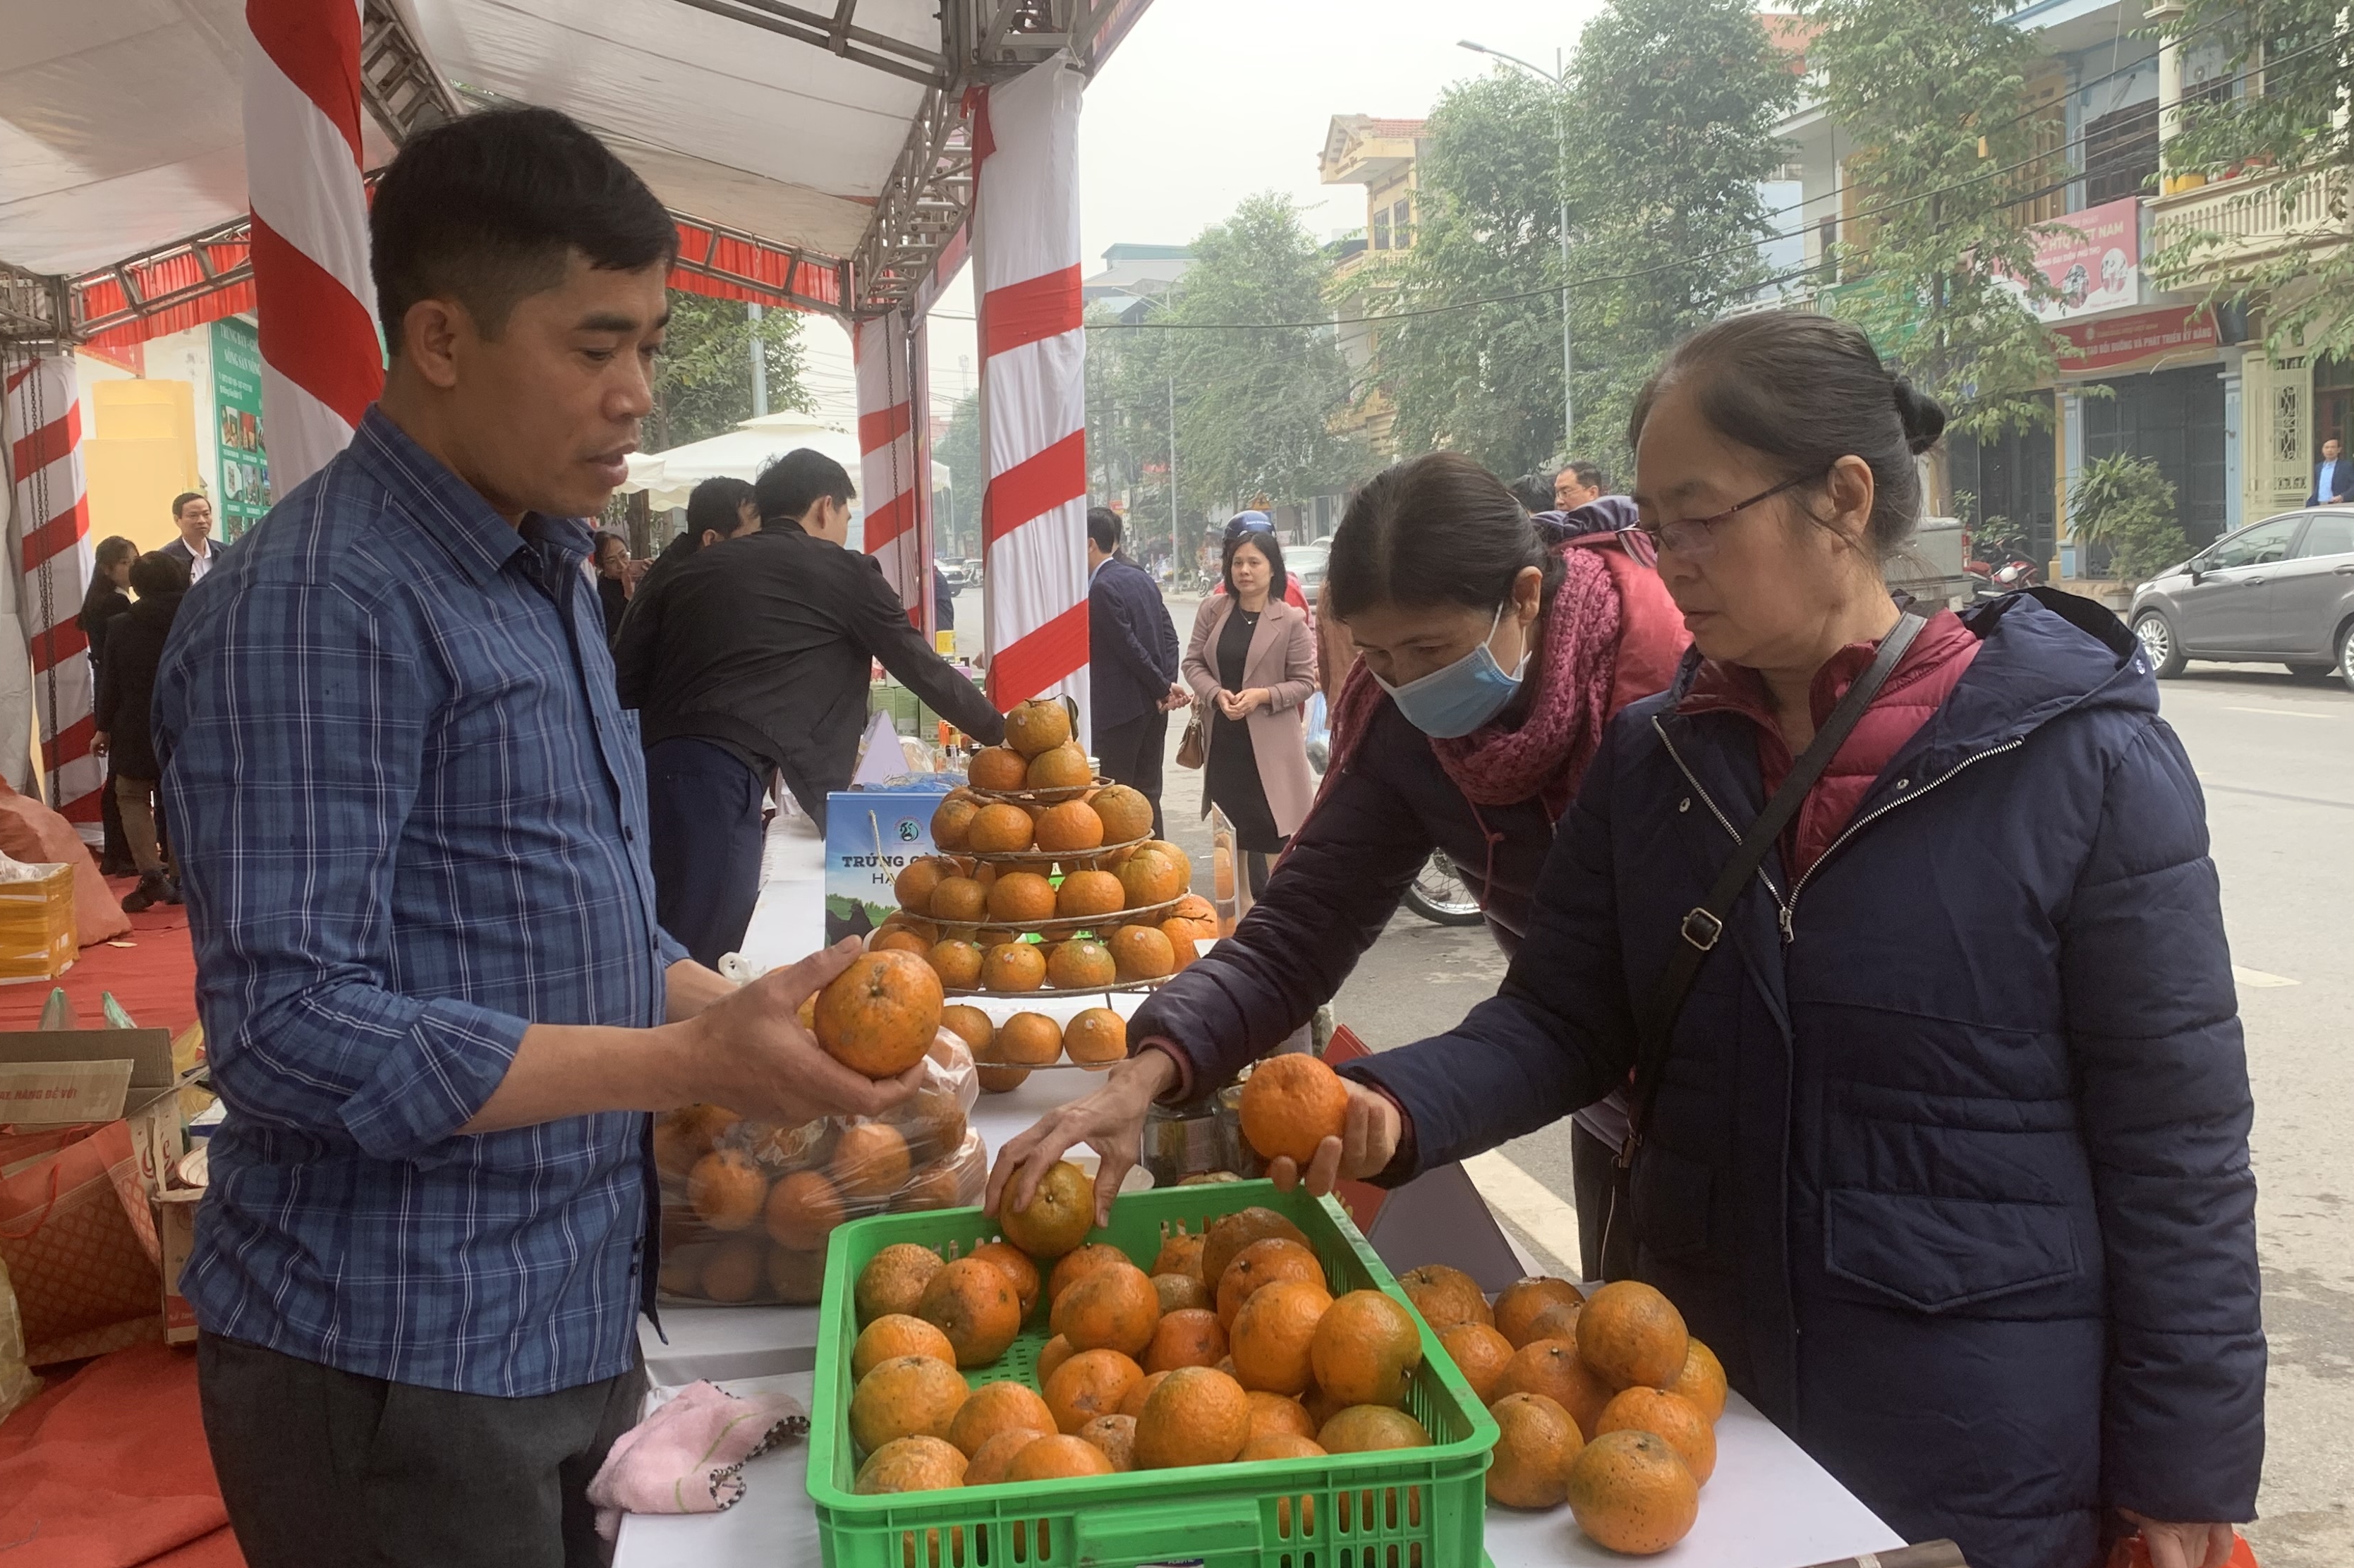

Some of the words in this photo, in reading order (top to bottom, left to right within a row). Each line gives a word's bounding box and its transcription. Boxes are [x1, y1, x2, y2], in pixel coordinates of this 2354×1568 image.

[2049, 236, 2071, 252] HTQ
[2099, 221, 2124, 239] NAM
[842, 852, 904, 868] TRỨNG
